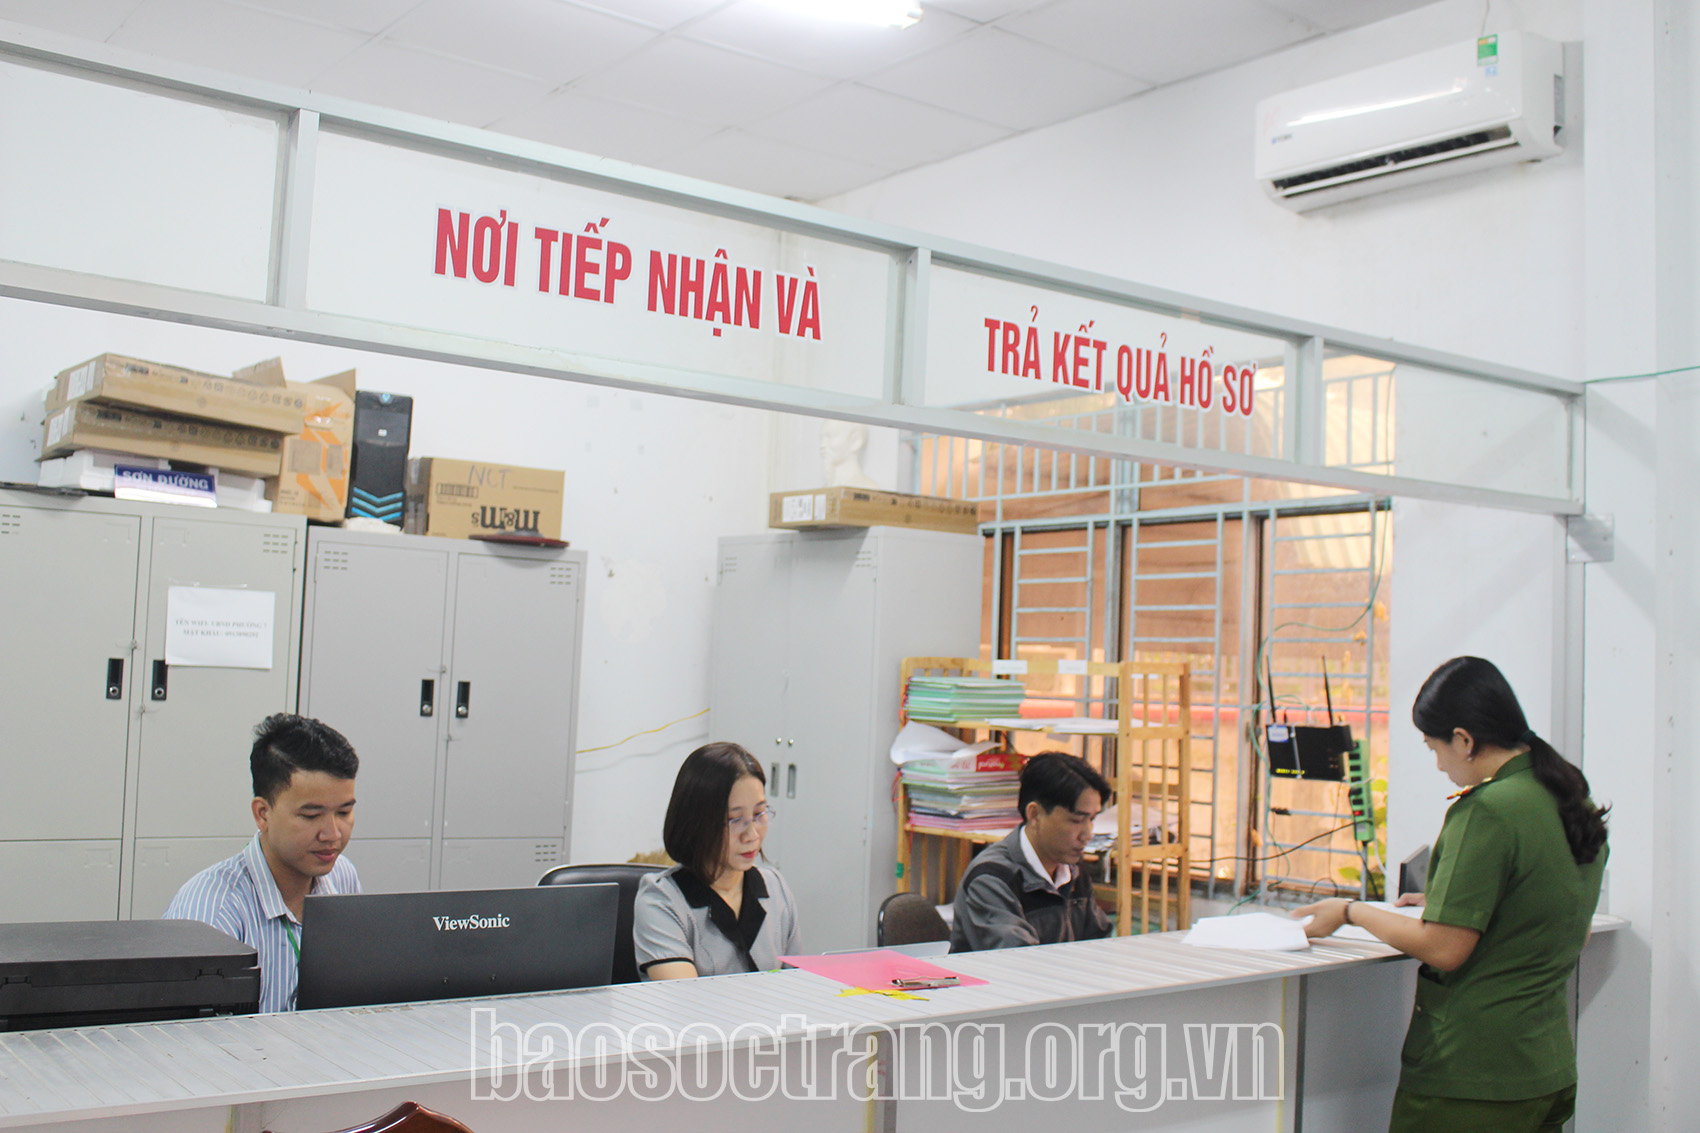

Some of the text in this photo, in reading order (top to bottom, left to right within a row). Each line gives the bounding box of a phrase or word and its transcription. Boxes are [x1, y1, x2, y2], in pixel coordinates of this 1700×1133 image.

[434, 208, 822, 341] NƠI TIẾP NHẬN VÀ
[984, 305, 1257, 416] TRẢ KẾT QUẢ HỒ SƠ
[122, 470, 153, 482] SƠN
[467, 464, 512, 488] NCT
[432, 913, 511, 931] ViewSonic
